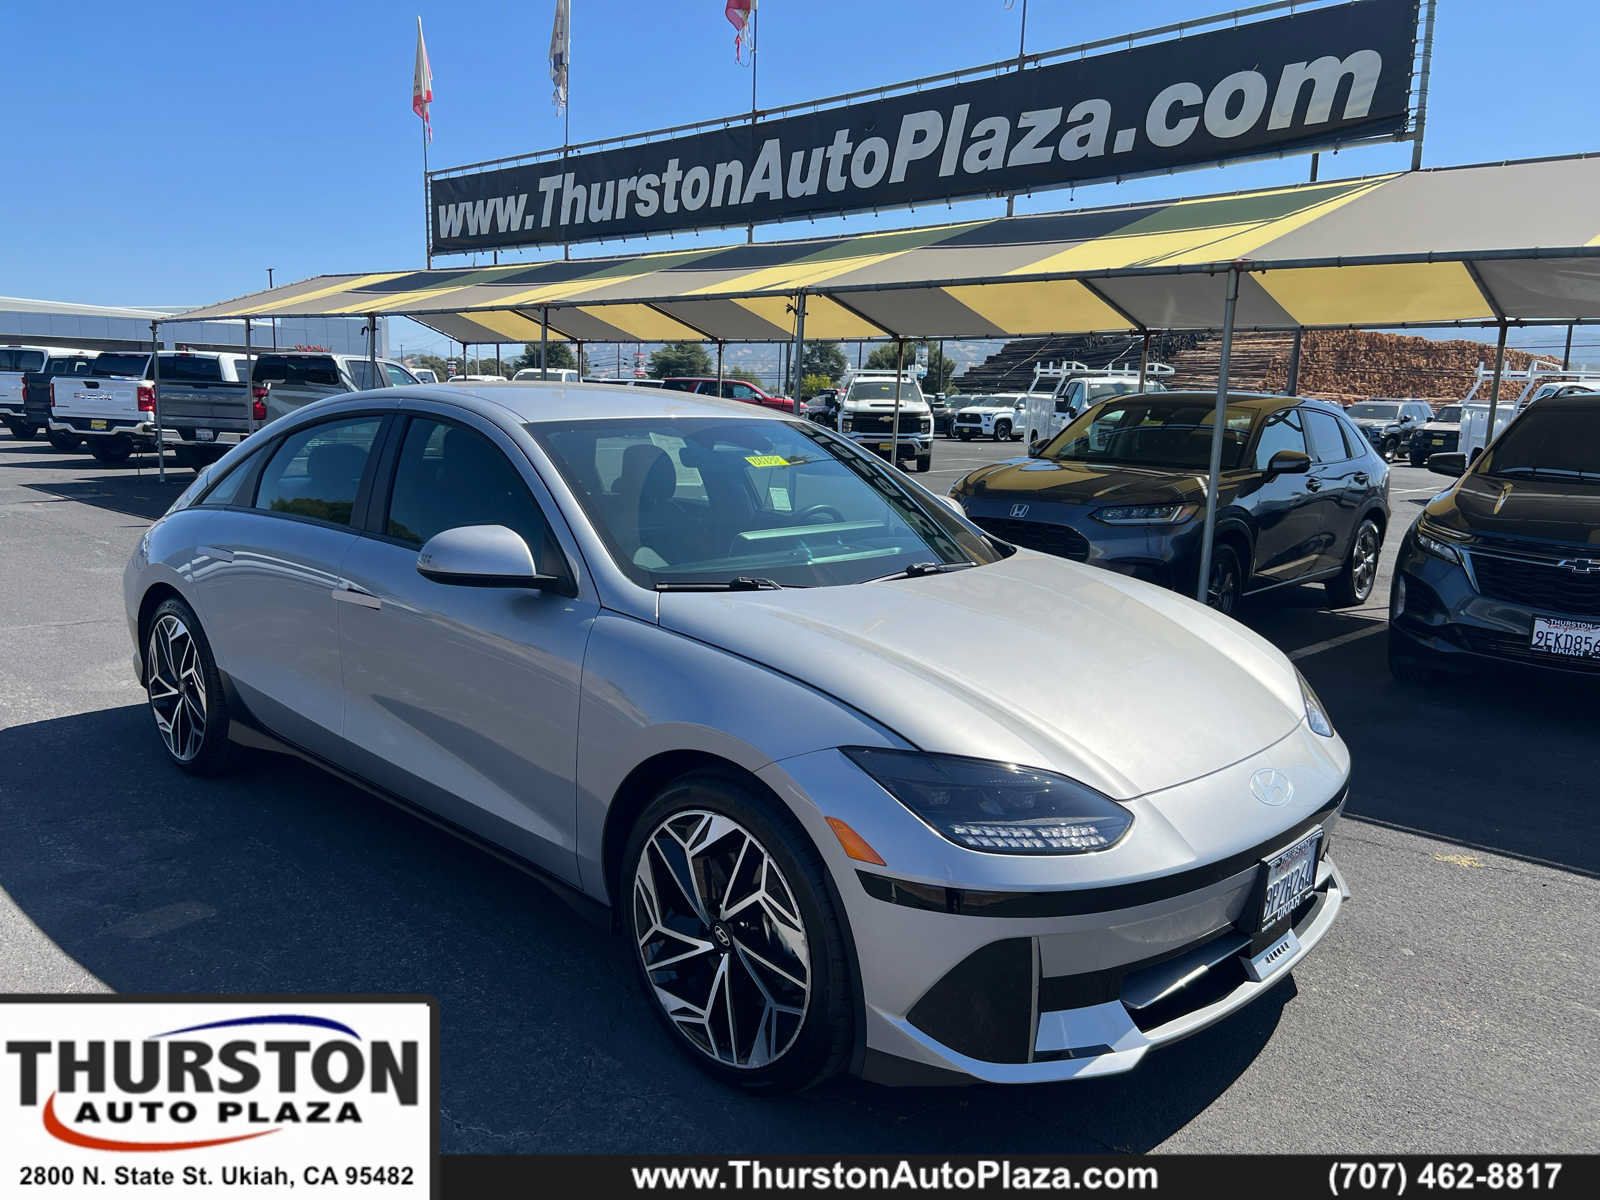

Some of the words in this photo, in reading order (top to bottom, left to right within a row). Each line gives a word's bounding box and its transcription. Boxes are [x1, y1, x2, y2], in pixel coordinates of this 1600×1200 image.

[438, 48, 1383, 239] www.ThurstonAutoPlaza.com
[1551, 619, 1593, 630] THURSTON
[1551, 647, 1584, 657] UKIAH
